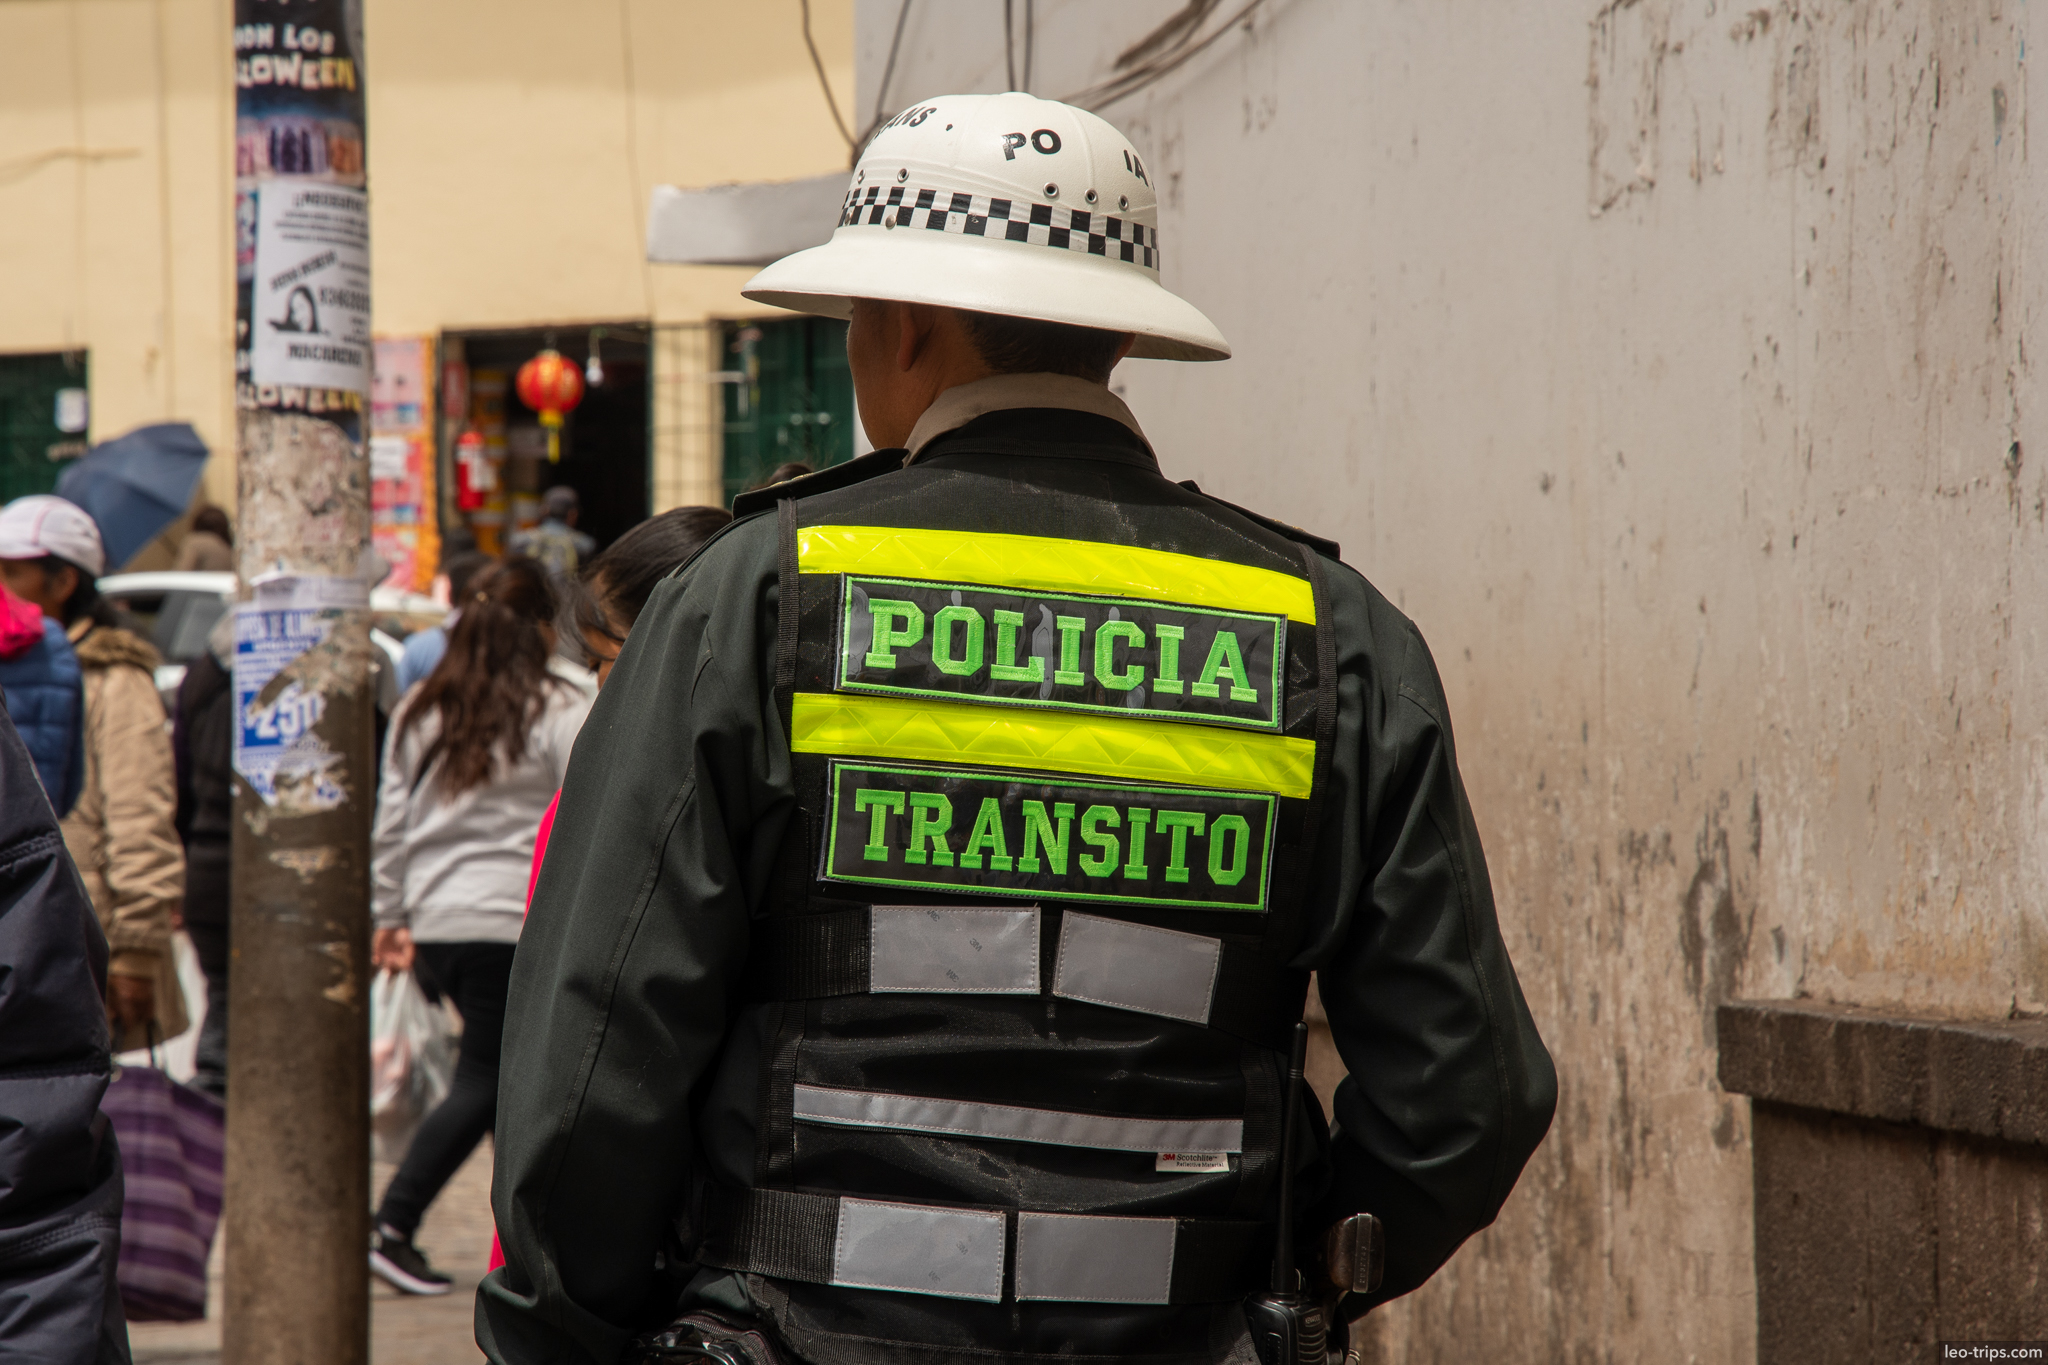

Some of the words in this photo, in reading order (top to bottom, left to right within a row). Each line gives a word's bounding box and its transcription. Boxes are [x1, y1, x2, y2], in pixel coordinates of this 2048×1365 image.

[865, 598, 1257, 703] POLICIA
[855, 788, 1250, 886] TRANSITO
[969, 938, 982, 952] 3M
[1162, 1153, 1175, 1161] 3M
